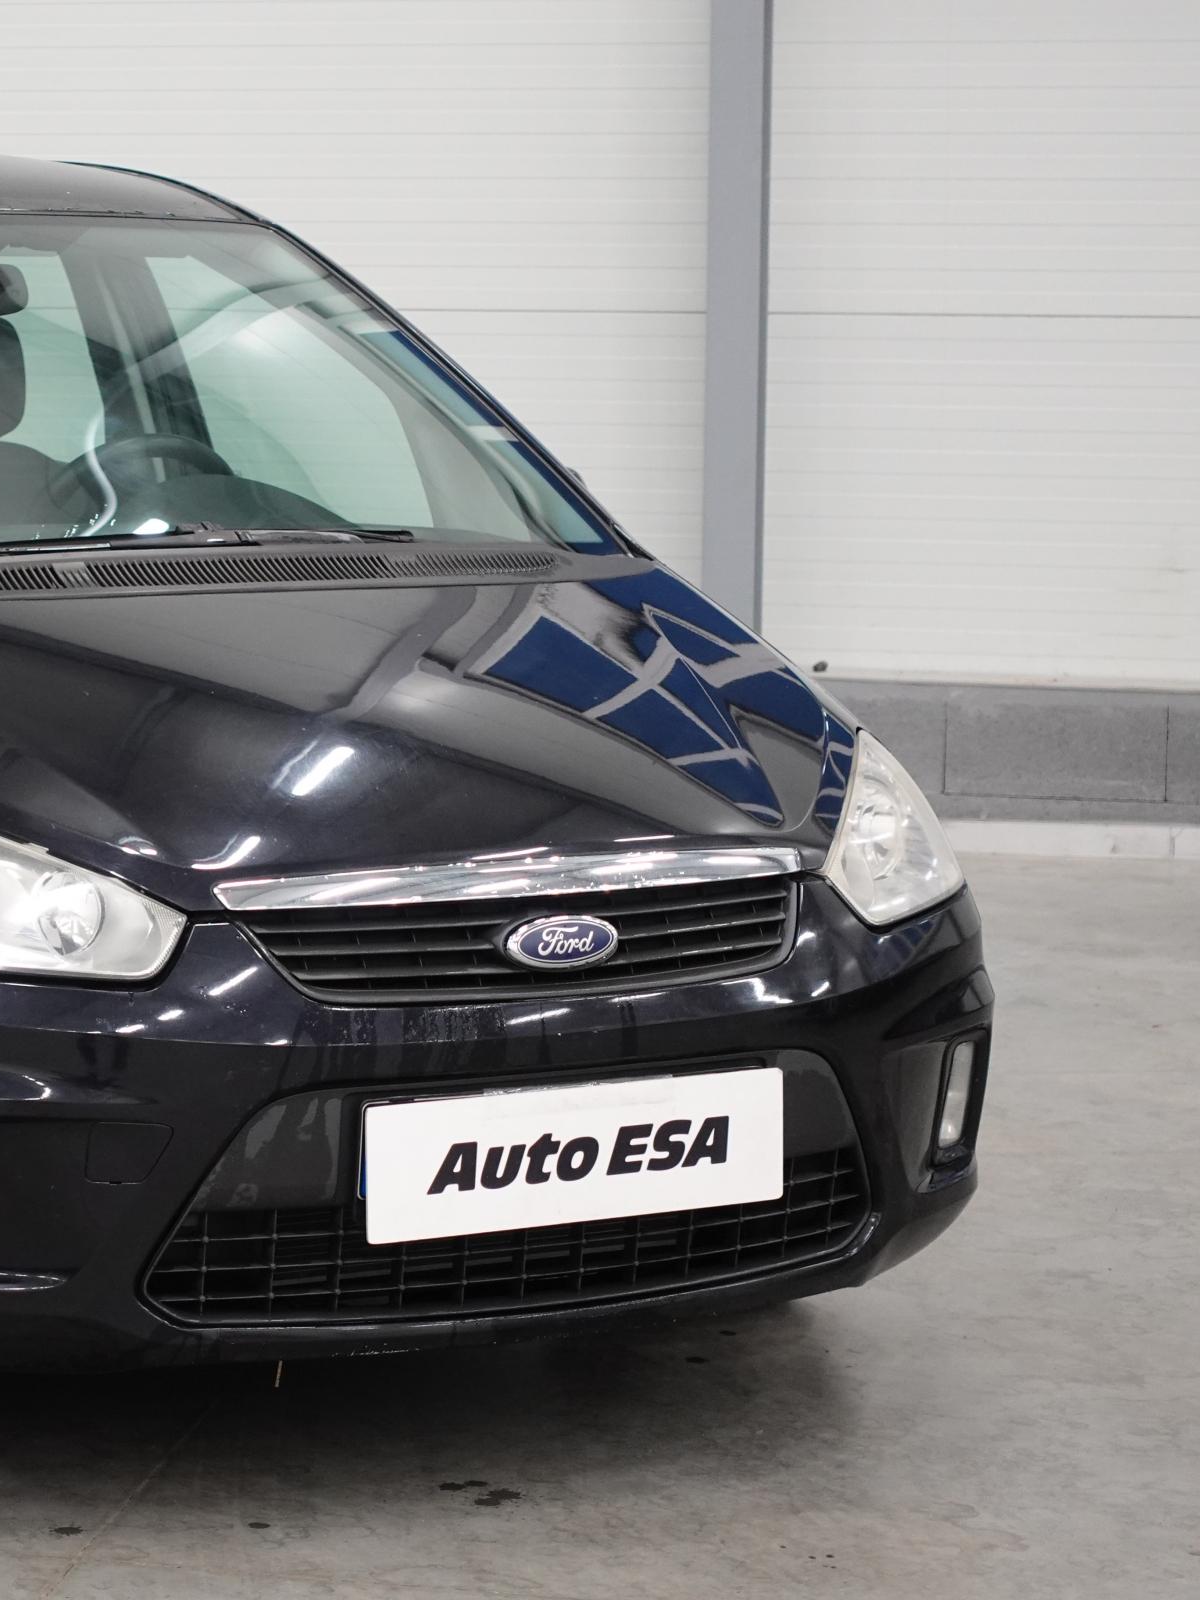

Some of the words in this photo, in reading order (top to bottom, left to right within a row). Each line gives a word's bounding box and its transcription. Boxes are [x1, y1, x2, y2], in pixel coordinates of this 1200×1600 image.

[538, 926, 594, 956] Ford
[427, 1133, 599, 1195] Auto
[606, 1115, 729, 1176] ESA
